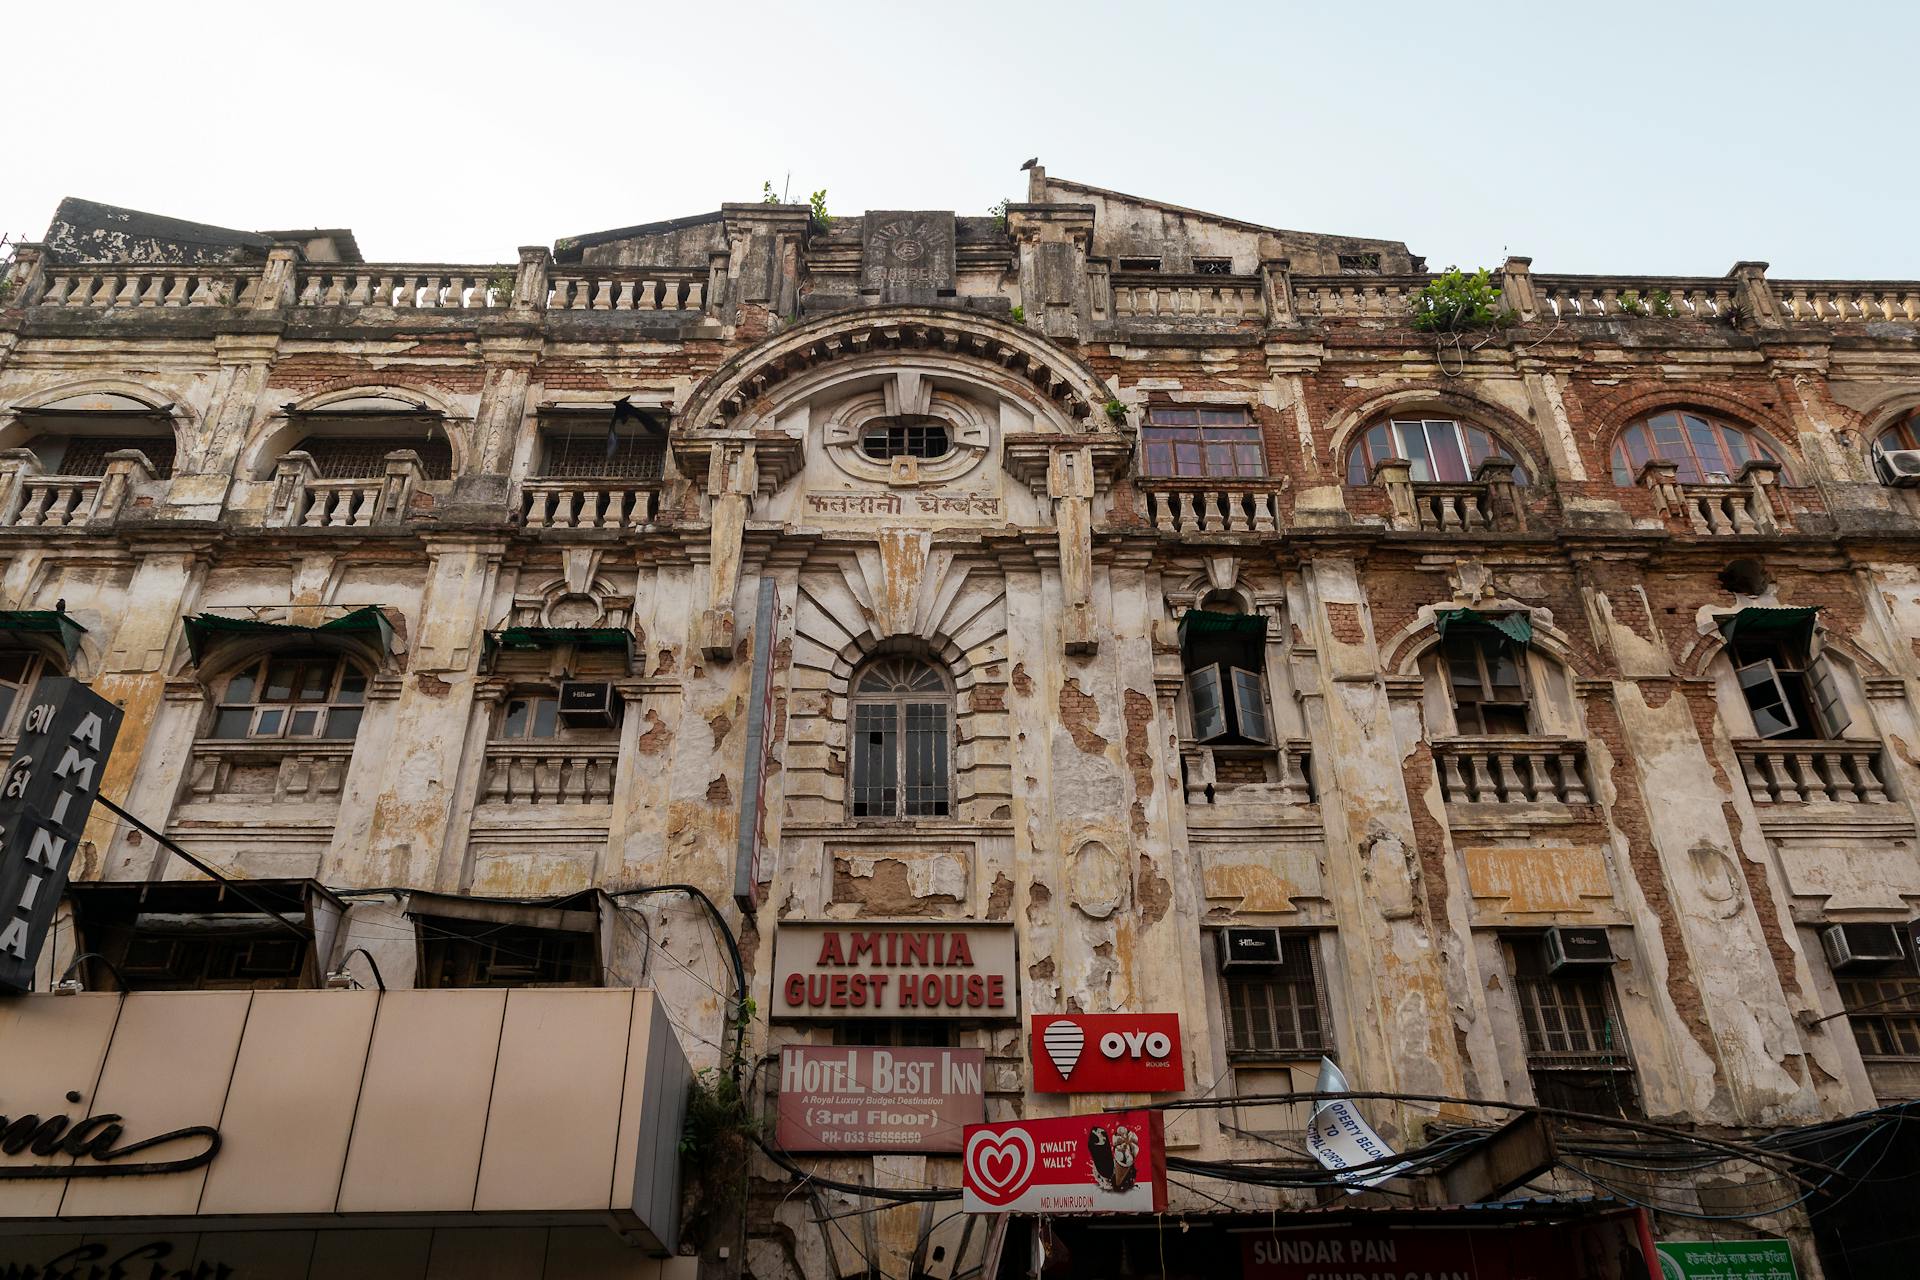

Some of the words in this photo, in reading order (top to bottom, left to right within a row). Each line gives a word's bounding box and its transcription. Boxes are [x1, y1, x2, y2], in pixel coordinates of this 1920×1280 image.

[0, 710, 103, 960] AMINIA
[816, 931, 974, 967] AMINIA
[784, 973, 889, 1008] GUEST
[898, 973, 1006, 1008] HOUSE
[1099, 1030, 1172, 1059] OYO
[872, 1050, 934, 1094] BEST
[941, 1051, 981, 1095] INN
[802, 1096, 810, 1104] A
[810, 1096, 834, 1105] Royal
[836, 1096, 864, 1106] Luxury
[865, 1096, 895, 1106] Budget
[897, 1096, 944, 1105] Destination
[805, 1108, 858, 1127] (3rd
[867, 1109, 938, 1128] Floor)
[844, 1131, 865, 1144] 033
[1323, 1123, 1339, 1138] TO
[1040, 1140, 1078, 1154] KWALITY
[1040, 1197, 1052, 1208] MD.
[1053, 1195, 1094, 1208] MUNIRUDDIN
[1253, 1239, 1345, 1265] SUNDAR
[1348, 1239, 1398, 1264] PAN
